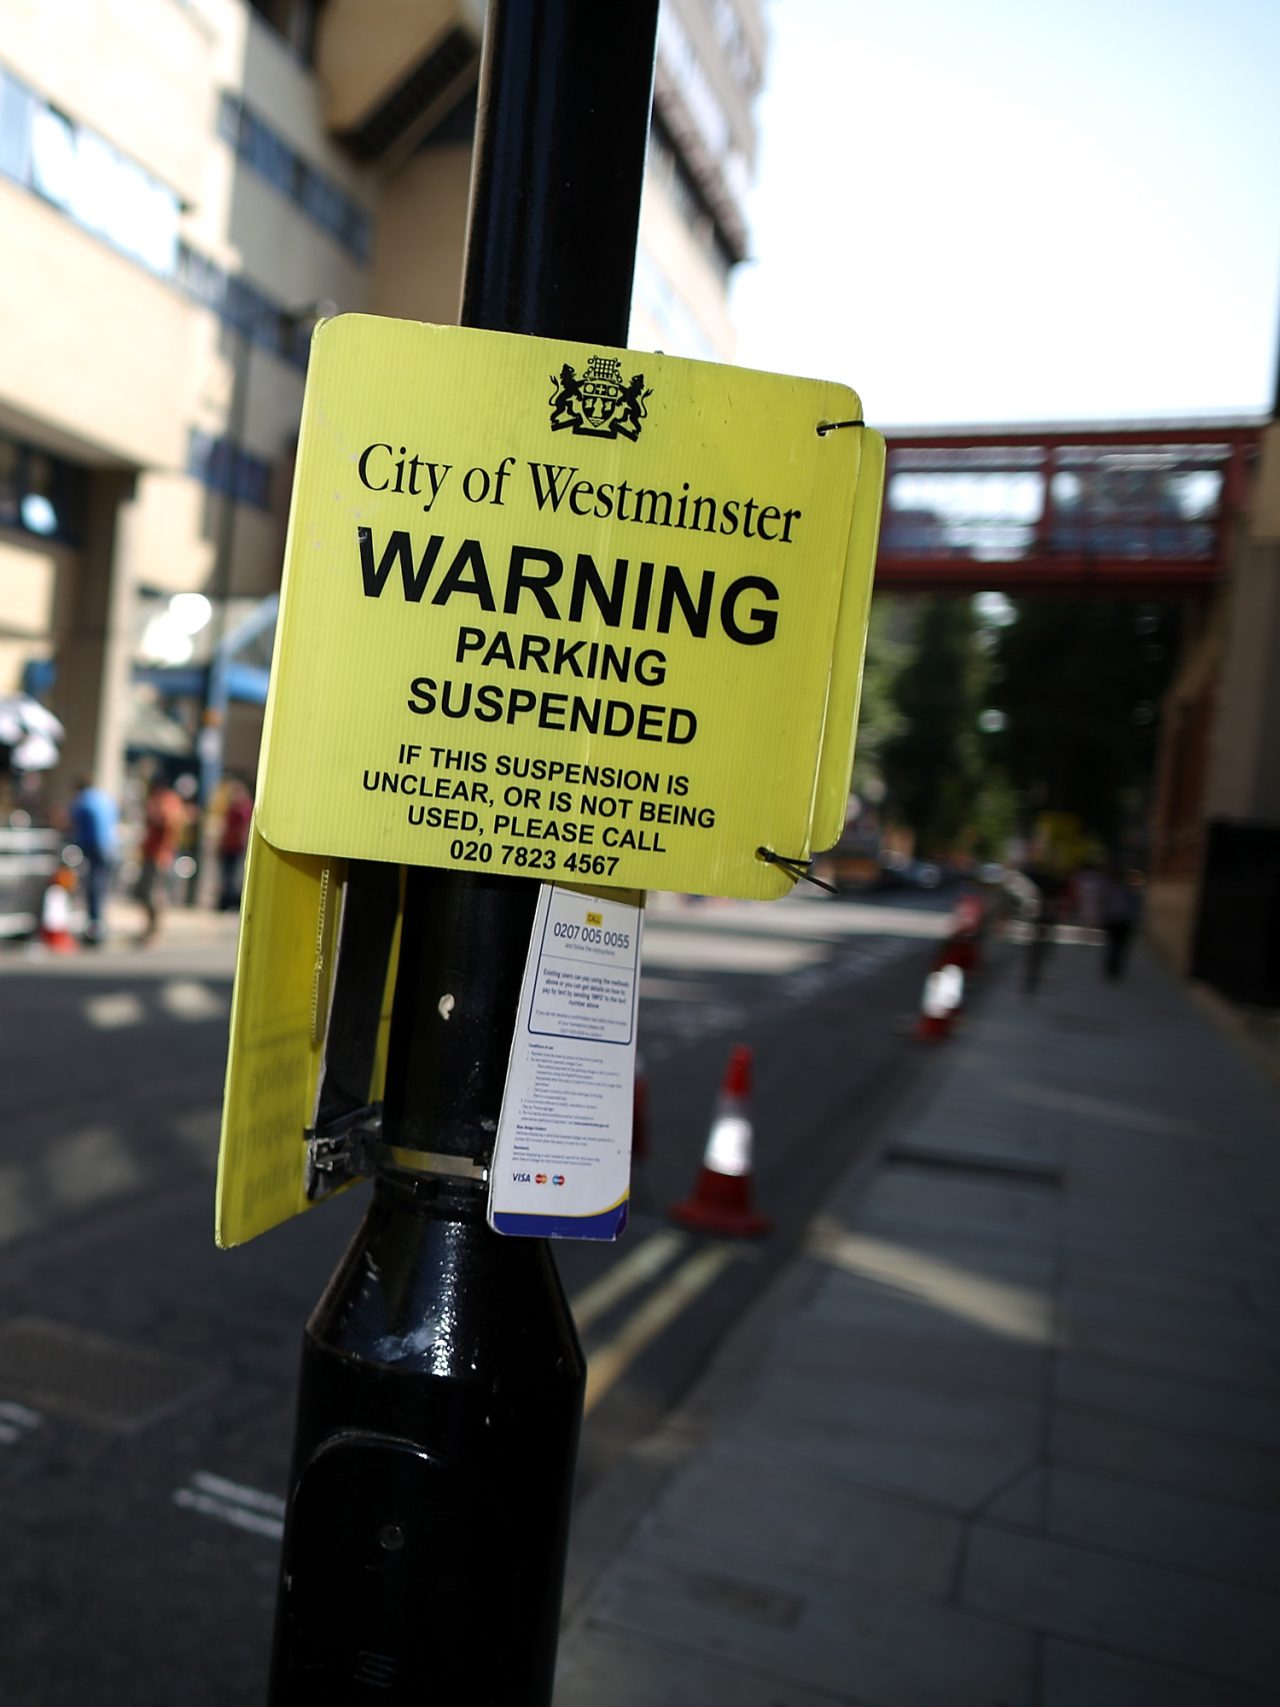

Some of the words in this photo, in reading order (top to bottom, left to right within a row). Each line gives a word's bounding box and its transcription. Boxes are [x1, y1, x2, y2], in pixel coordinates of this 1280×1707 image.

[357, 442, 453, 513] City
[462, 456, 517, 506] of
[527, 461, 802, 544] Westminster
[357, 526, 780, 646] WARNING
[455, 626, 667, 687] PARKING
[407, 677, 698, 745] SUSPENDED
[398, 743, 422, 765] IF
[429, 747, 488, 774] THIS
[495, 754, 660, 794] SUSPENSION
[666, 774, 690, 797] IS
[362, 770, 494, 808] UNCLEAR,
[503, 786, 542, 810] OR
[548, 790, 572, 813] IS
[580, 794, 634, 820] NOT
[639, 801, 716, 829] BEING
[407, 804, 484, 836] USED,
[493, 814, 595, 845] PLEASE
[602, 826, 667, 853] CALL
[450, 839, 493, 863] 020
[501, 844, 557, 871] 7823
[562, 852, 620, 877] 4567
[553, 922, 580, 939] 0207
[581, 927, 602, 944] 005
[603, 931, 630, 949] 0055
[512, 1172, 531, 1183] VISA
